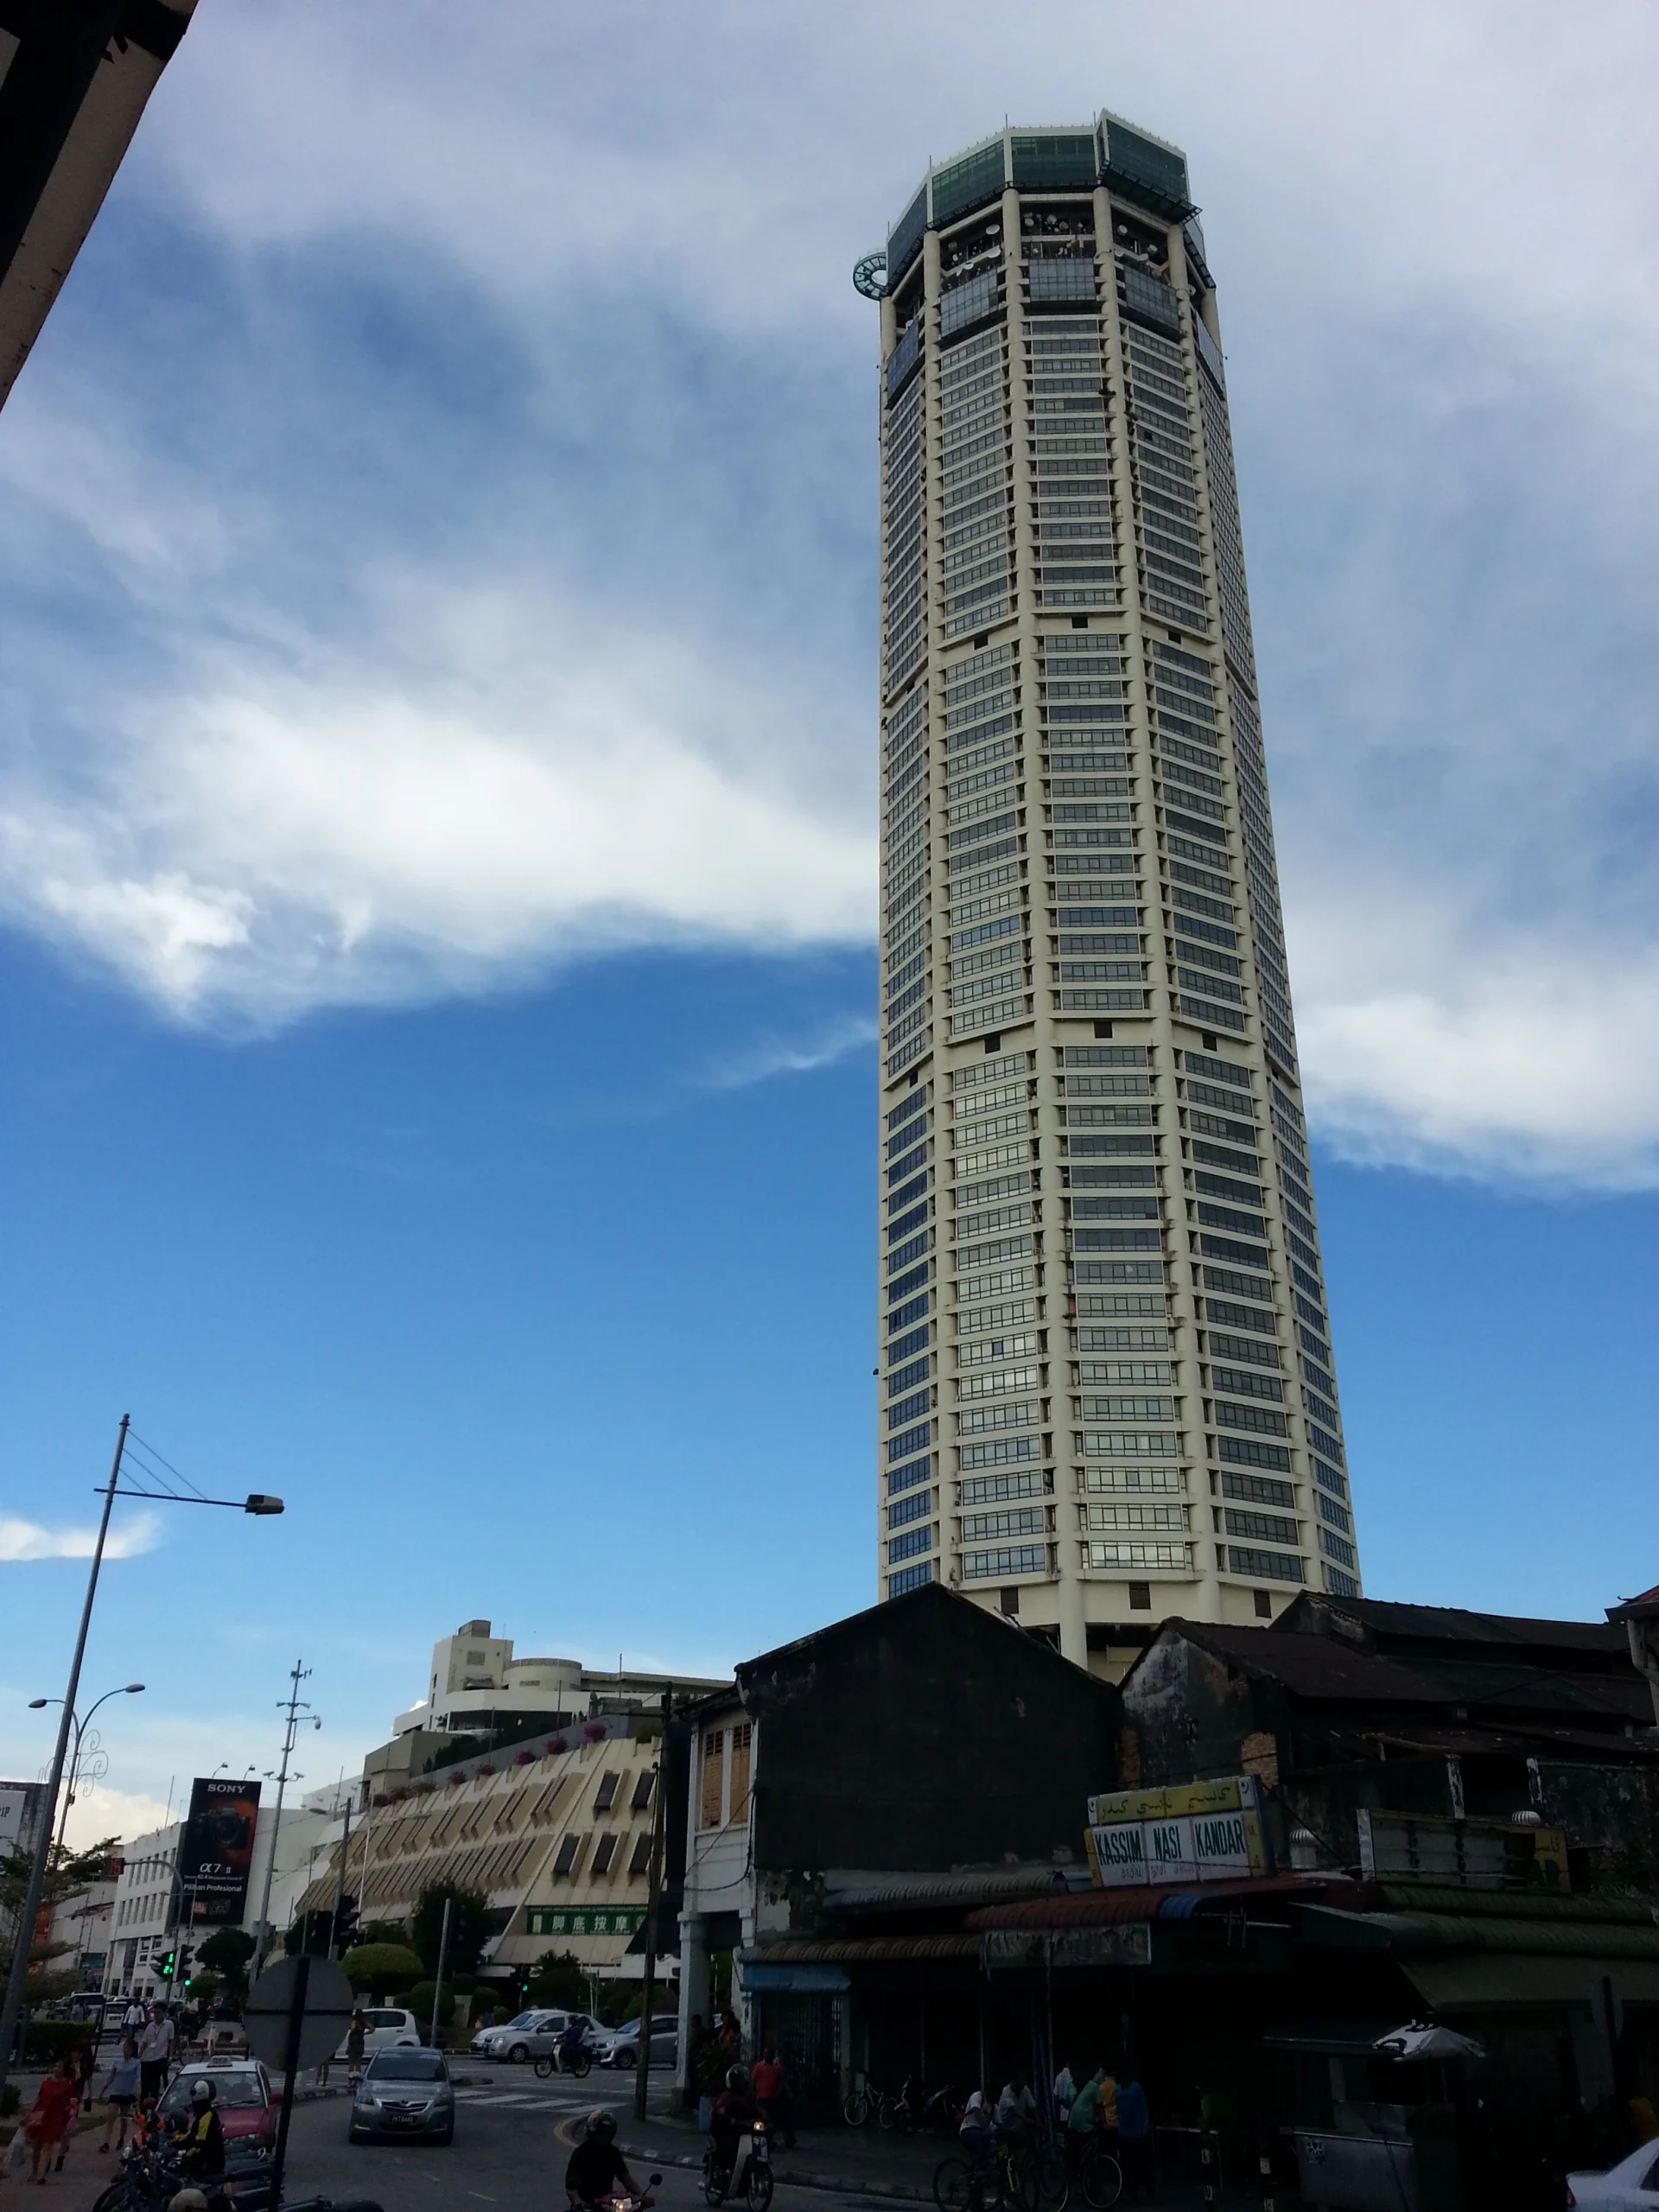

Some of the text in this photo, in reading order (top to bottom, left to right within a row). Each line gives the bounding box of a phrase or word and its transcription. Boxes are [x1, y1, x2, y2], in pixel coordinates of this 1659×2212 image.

[207, 1783, 246, 1793] SONY
[1095, 1818, 1246, 1866] KASSIM NASI KANDAR
[207, 1884, 242, 1892] Profesional
